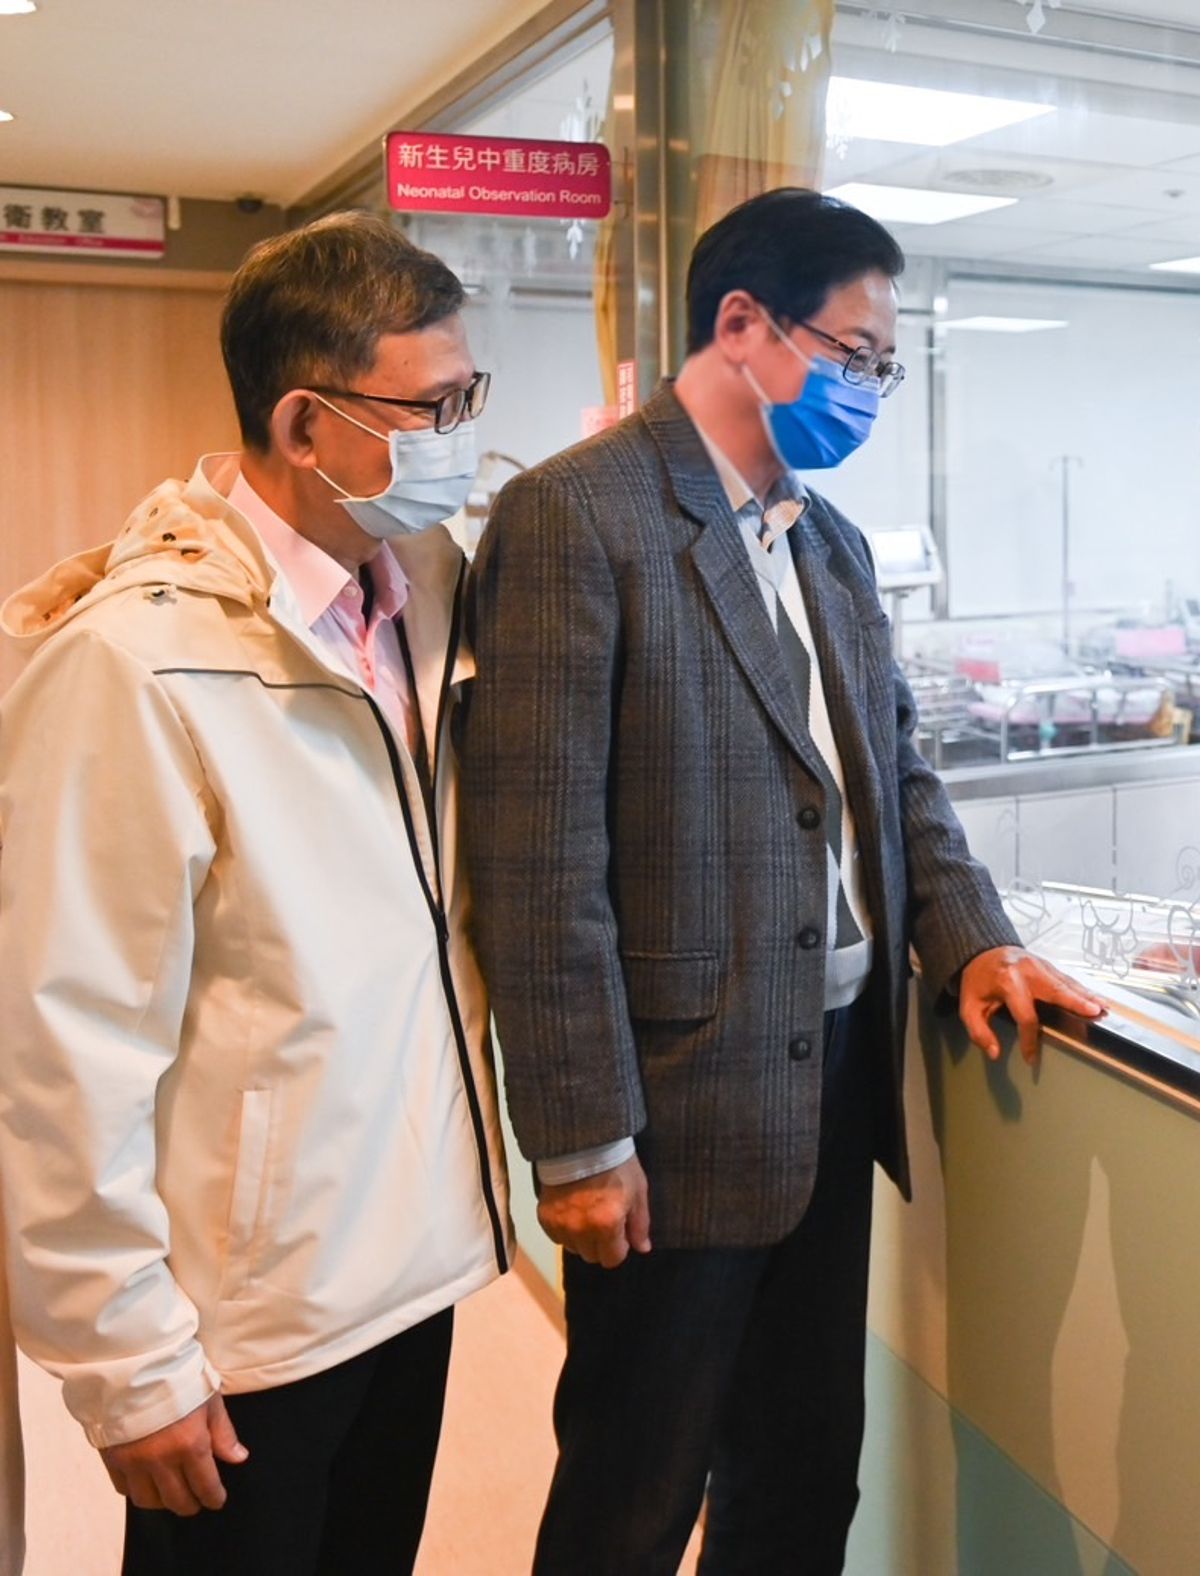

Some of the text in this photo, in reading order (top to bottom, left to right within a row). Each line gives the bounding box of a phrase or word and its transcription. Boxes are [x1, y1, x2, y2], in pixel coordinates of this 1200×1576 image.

[400, 143, 599, 177] 新生兒中重度病房
[397, 183, 602, 204] Neonatal Observation Room
